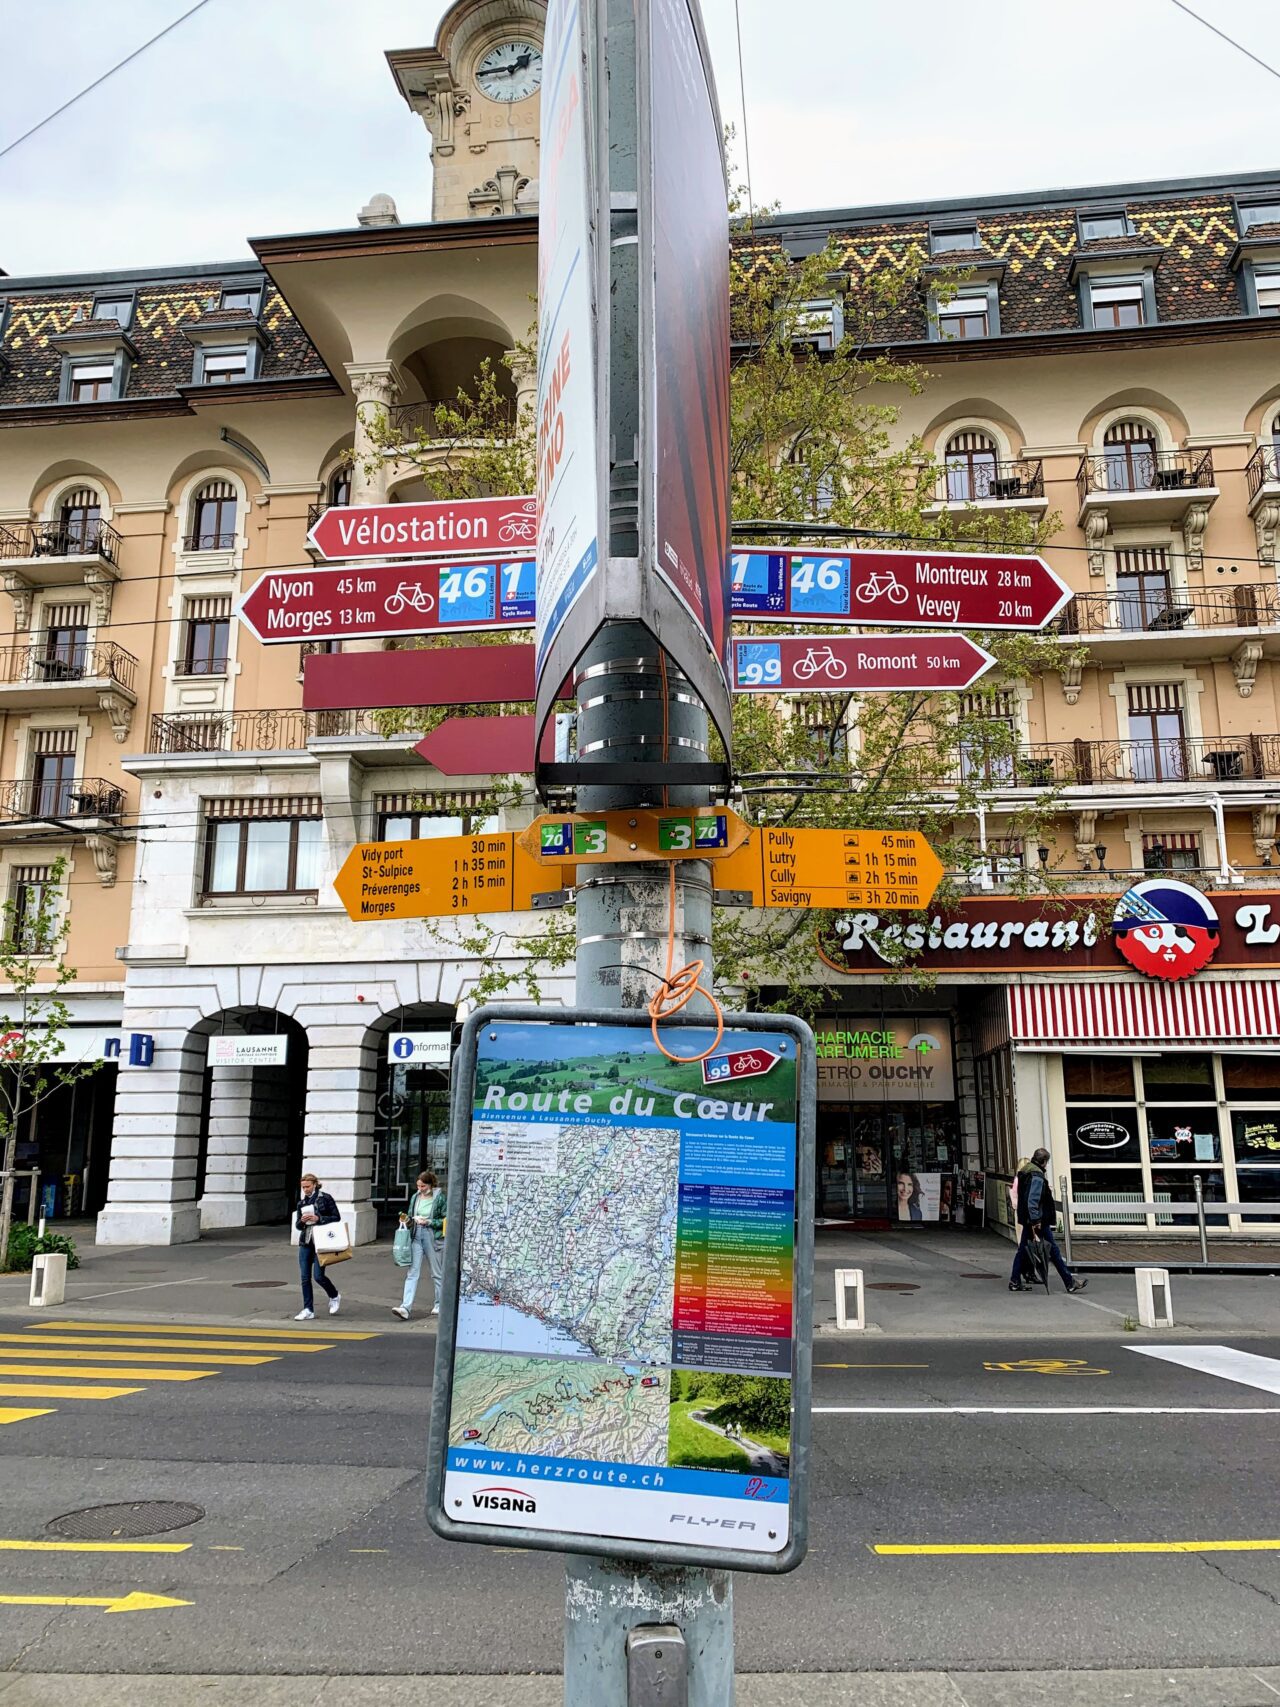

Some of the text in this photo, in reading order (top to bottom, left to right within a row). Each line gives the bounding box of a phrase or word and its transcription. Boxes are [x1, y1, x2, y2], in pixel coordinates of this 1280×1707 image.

[338, 512, 488, 545] Vélostation
[439, 567, 489, 603] 46
[502, 562, 523, 598] 1
[791, 560, 843, 593] 46
[916, 562, 1032, 588] Montreux 28 km
[269, 577, 377, 604] Nyon 45 km
[769, 597, 781, 606] 17
[916, 594, 1033, 623] Vevey 20 km
[267, 608, 376, 633] Morges 13 km
[857, 652, 961, 670] Romont 50 km
[745, 659, 781, 685] 99
[545, 834, 564, 847] 70
[586, 829, 607, 854] 3
[671, 825, 692, 850] 3
[698, 827, 718, 840] 70
[768, 832, 916, 848] Pully 45 min
[361, 839, 506, 863] Vidy port 30 min
[769, 851, 917, 868] Lutry 1 h 15 min
[454, 860, 458, 872] 1
[462, 859, 468, 872] h
[471, 858, 485, 872] 35
[487, 858, 506, 870] min
[361, 875, 506, 897] Préverenges 2 h 15 min
[770, 869, 918, 886] Cully 2 h 15 min
[361, 895, 468, 916] Morges 3 h
[771, 889, 919, 905] Savigny 3 h 20 min
[835, 912, 1098, 965] Restaurant
[814, 1031, 897, 1044] HARMACIE
[815, 1045, 905, 1059] ARFUMERIE
[711, 1064, 731, 1080] 99
[817, 1065, 934, 1079] ETRO OUCHY
[482, 1085, 774, 1123] Route du Cœur
[481, 1112, 527, 1120] Bienvenue
[539, 1114, 612, 1126] Lausanne-Ouchy
[455, 1456, 665, 1488] www.herzroute.ch
[669, 1514, 756, 1531] FLYER
